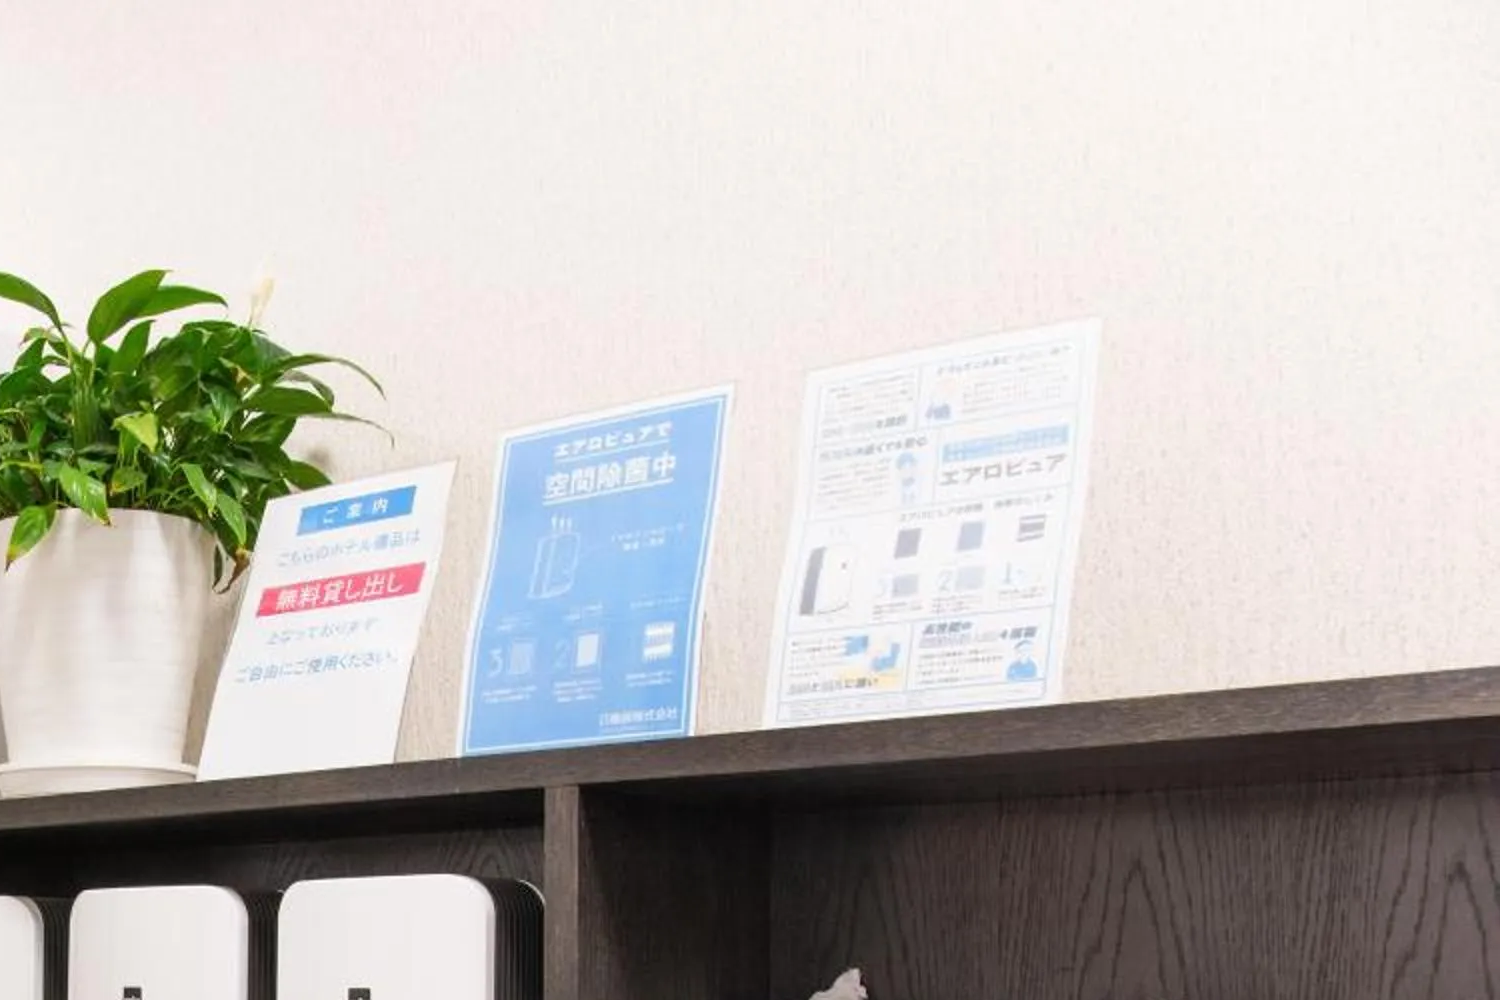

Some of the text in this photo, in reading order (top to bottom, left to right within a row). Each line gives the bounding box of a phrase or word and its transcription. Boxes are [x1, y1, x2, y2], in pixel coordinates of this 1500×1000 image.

[553, 420, 673, 458] エアロピュアで
[543, 450, 677, 499] 空間除菌中
[938, 452, 1067, 487] エアロピュア
[323, 497, 390, 524] ご案内
[275, 571, 403, 612] 無料貸し出し
